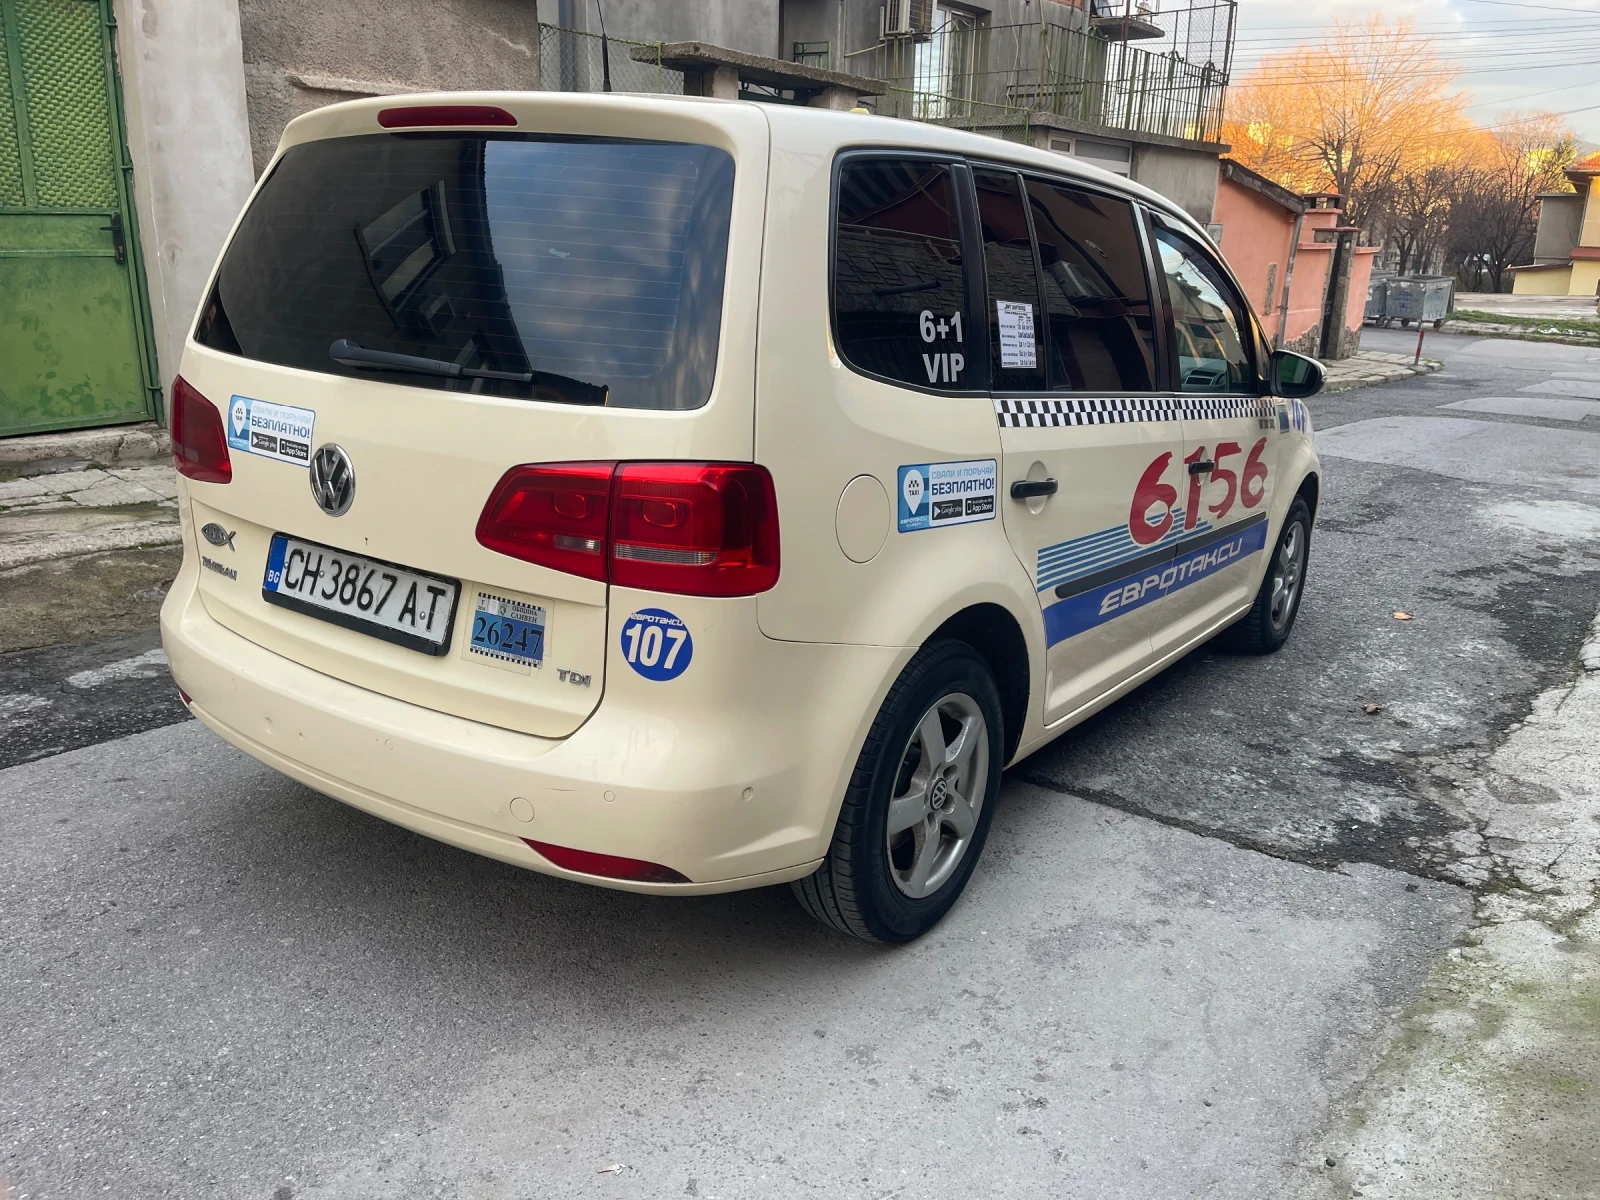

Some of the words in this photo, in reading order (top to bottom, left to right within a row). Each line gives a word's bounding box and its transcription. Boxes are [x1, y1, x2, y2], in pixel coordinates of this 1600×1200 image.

[919, 309, 963, 343] 6+1
[922, 353, 965, 383] VIP
[252, 405, 273, 417] СВАЛИ
[251, 416, 310, 438] БЕЗПЛАТНО!
[286, 447, 295, 456] App
[295, 448, 307, 458] Store
[931, 471, 955, 479] СВАЛИ
[956, 469, 962, 477] И
[963, 464, 994, 476] ПОРЪЧАЙ
[931, 478, 995, 496] БЕЗПЛАТНО!
[1128, 436, 1269, 545] 6156
[267, 569, 280, 583] BG
[1098, 537, 1243, 616] ЕВРОТАКСИ
[510, 612, 538, 623] СЛИВЕН
[512, 605, 538, 617] ОБЩИНА
[473, 616, 543, 655] 26247
[625, 623, 688, 670] 107
[556, 667, 592, 688] TDI
